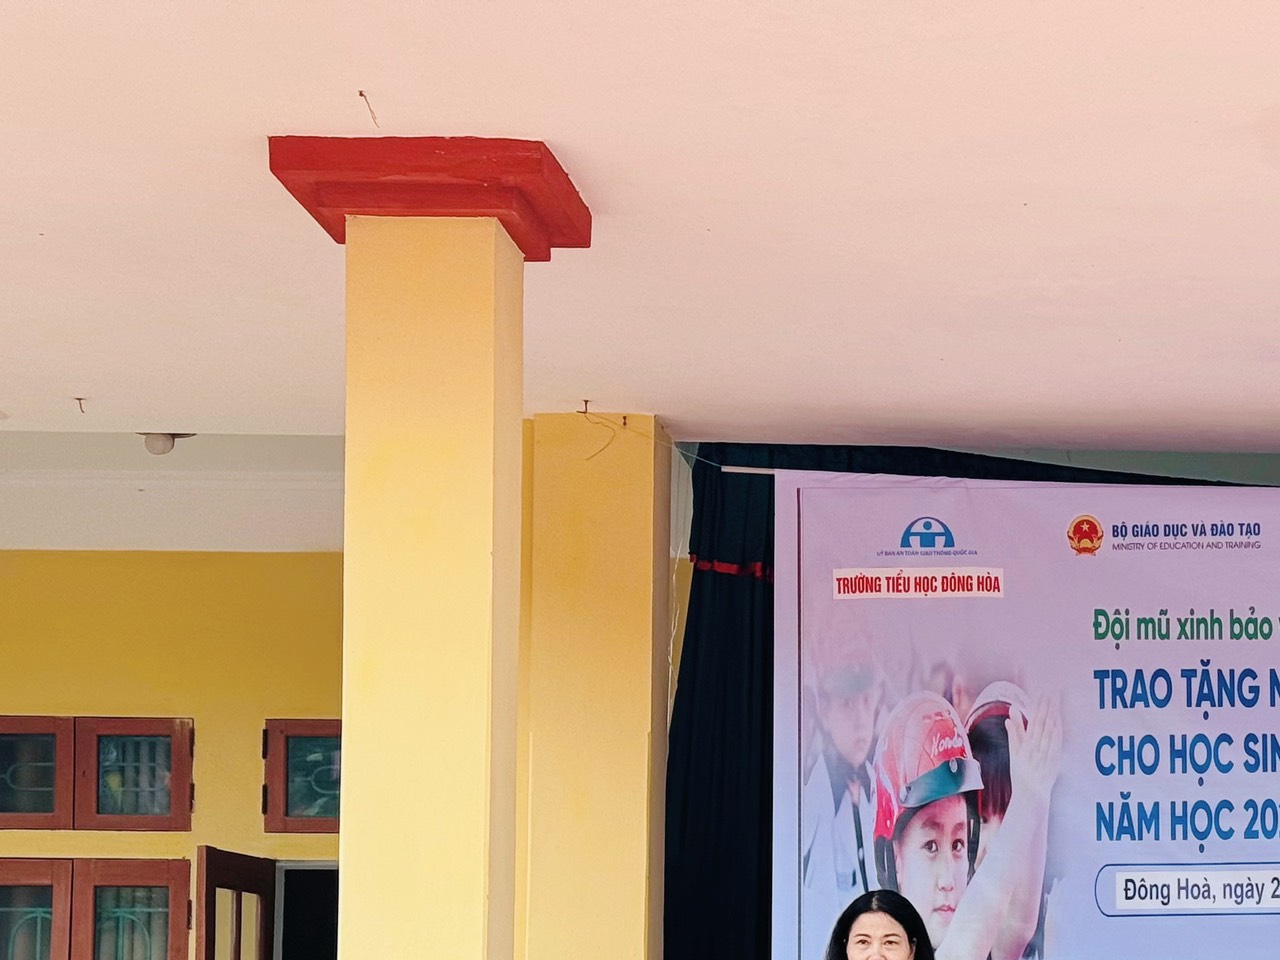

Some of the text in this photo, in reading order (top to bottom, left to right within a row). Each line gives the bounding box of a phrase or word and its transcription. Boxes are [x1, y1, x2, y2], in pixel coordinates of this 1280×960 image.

[1112, 520, 1261, 541] BỘ GIÁO DỤC VÀ ĐÀO TẠO
[1112, 541, 1261, 551] MINISTRY OF EDUCATION AND TRAINING
[836, 569, 1001, 597] TRƯỜNG TIỂU HỌC ĐÔNG HÒA
[1092, 607, 1130, 651] Đội
[1136, 608, 1171, 640] mũ
[1176, 607, 1224, 640] xinh
[1229, 605, 1273, 641] bảo
[1093, 668, 1173, 709] TRAO
[1180, 658, 1261, 721] TẶNG
[1094, 734, 1161, 776] CHO
[1169, 733, 1234, 787] HỌC
[1095, 791, 1160, 842] NĂM
[1169, 798, 1235, 854] HỌC
[1123, 877, 1171, 906] Đông
[1177, 877, 1216, 904] Hoà,
[1222, 877, 1265, 905] ngày
